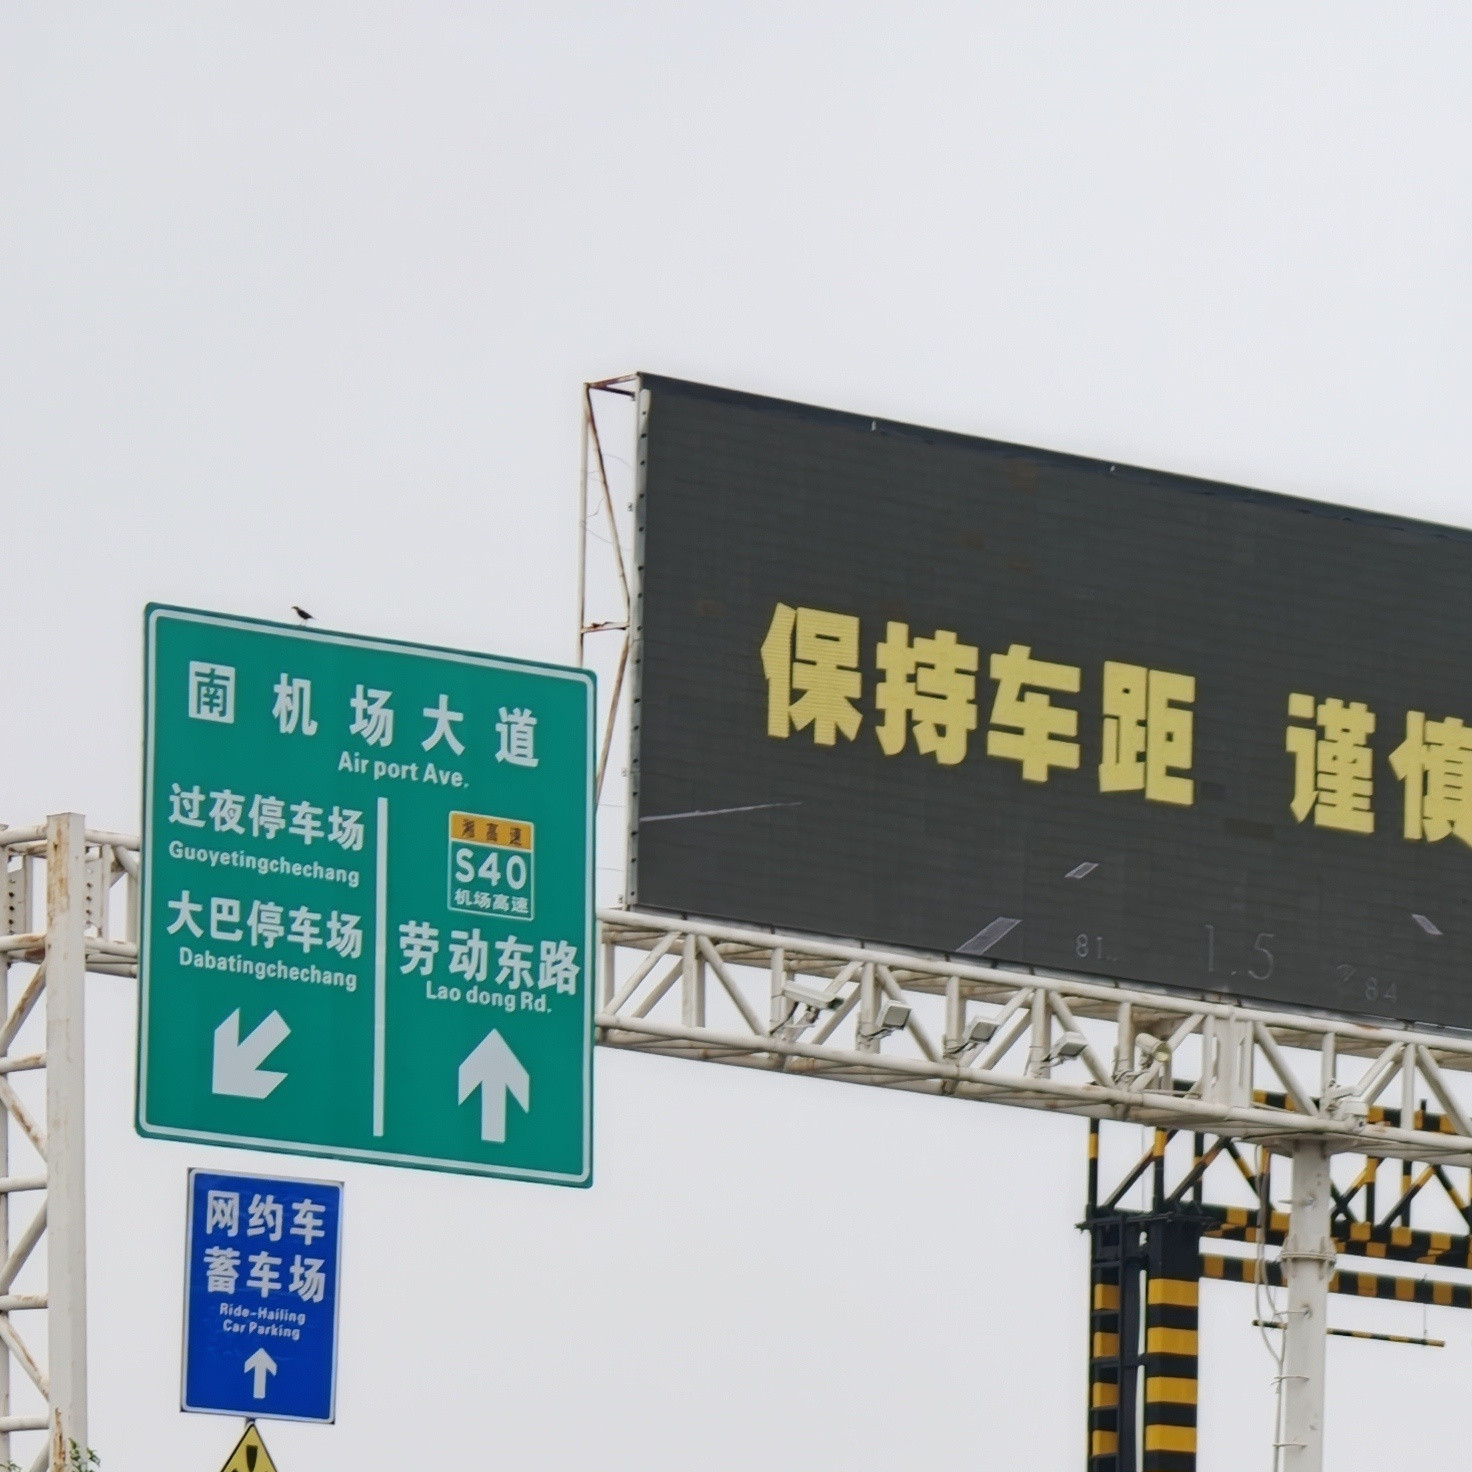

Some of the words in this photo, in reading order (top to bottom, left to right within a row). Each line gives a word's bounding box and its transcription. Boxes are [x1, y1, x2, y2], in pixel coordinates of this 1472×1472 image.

[760, 602, 1196, 807] 保持车距
[338, 751, 369, 773] Air
[373, 760, 418, 781] port
[423, 763, 469, 788] Ave.
[168, 783, 365, 851] 过夜停车场
[169, 840, 360, 888] Guoyetingchechang
[455, 847, 527, 890] S40
[454, 887, 529, 914] 机场高速
[167, 890, 363, 959] 大巴停车场
[179, 946, 358, 992] Dabatingchechang
[398, 919, 581, 996] 劳动东路
[426, 980, 461, 1001] Lao
[466, 985, 516, 1013] dong
[520, 991, 552, 1013] Rd.
[205, 1189, 325, 1245] 网约车
[203, 1246, 326, 1304] 蓄车场
[220, 1302, 306, 1325] Ride-Hailing
[223, 1319, 246, 1333] Car
[249, 1321, 300, 1341] Parking
